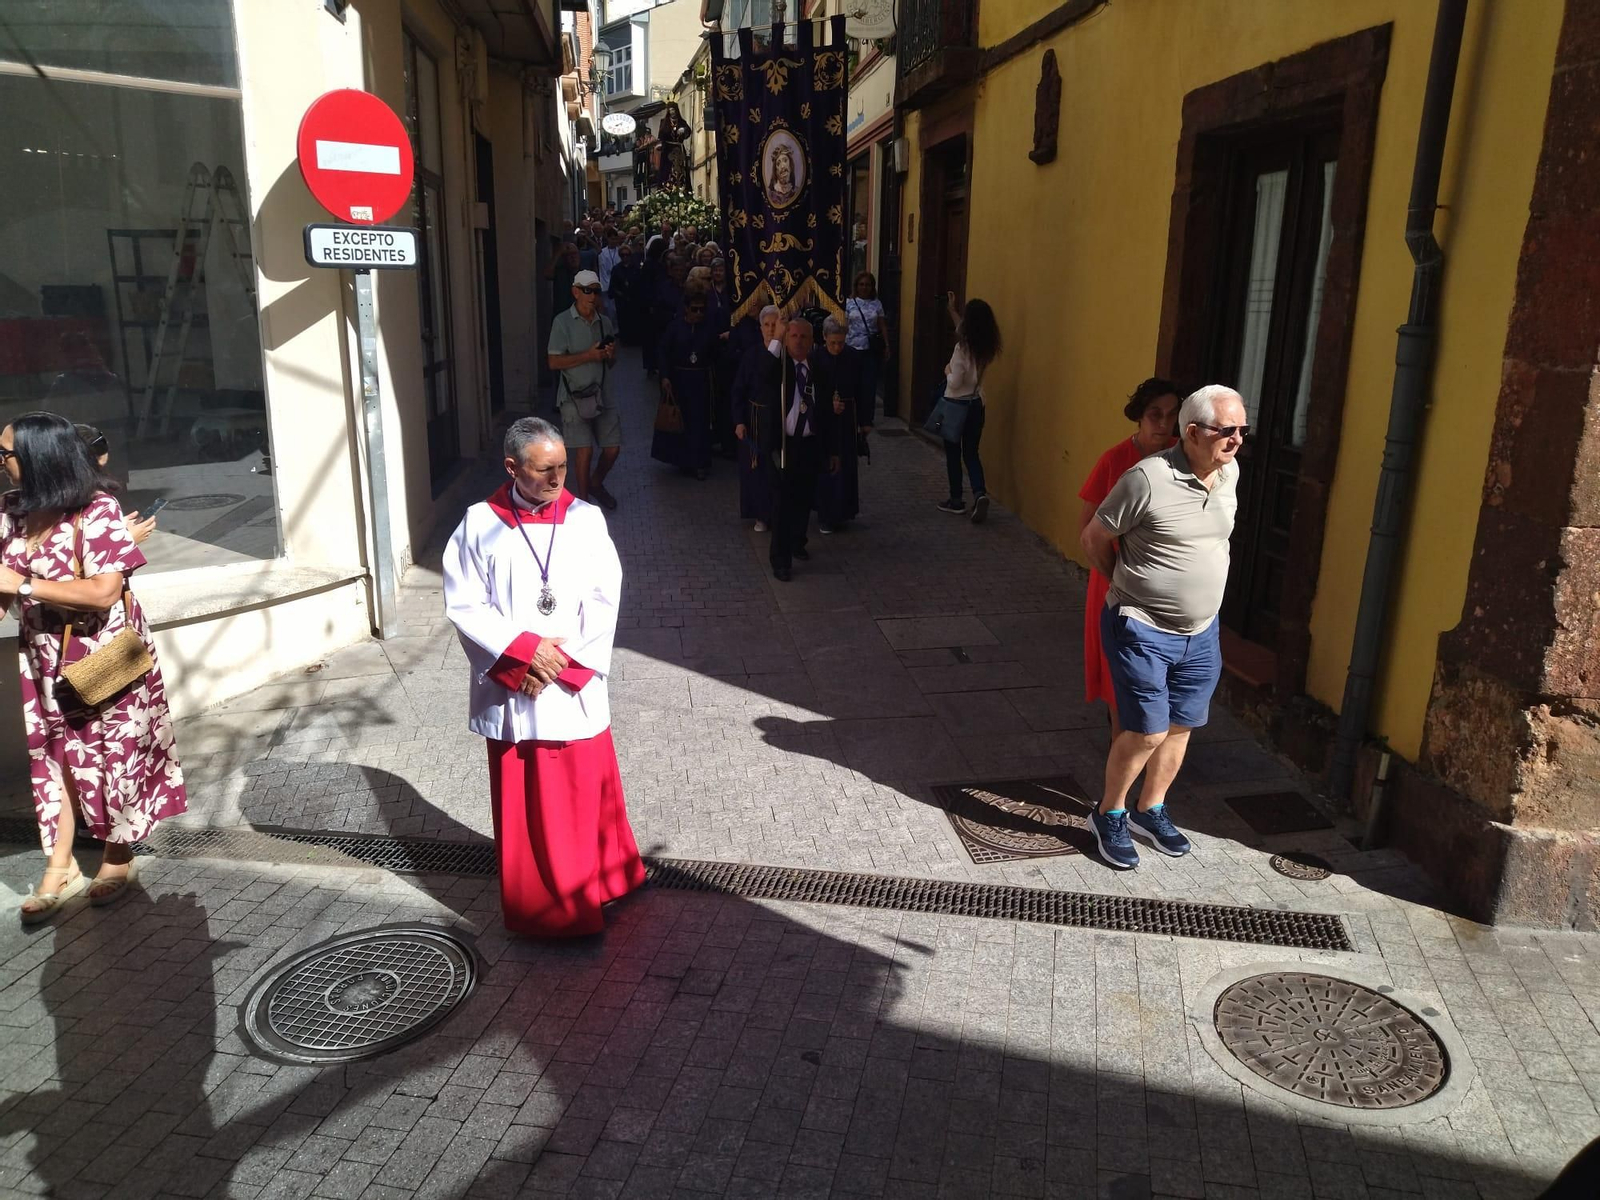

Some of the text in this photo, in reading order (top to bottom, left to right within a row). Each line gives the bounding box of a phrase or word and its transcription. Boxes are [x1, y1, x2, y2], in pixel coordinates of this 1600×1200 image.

[333, 231, 395, 247] EXCEPTO
[323, 247, 406, 262] RESIDENTES
[1362, 1027, 1423, 1095] SANEAMIENTO
